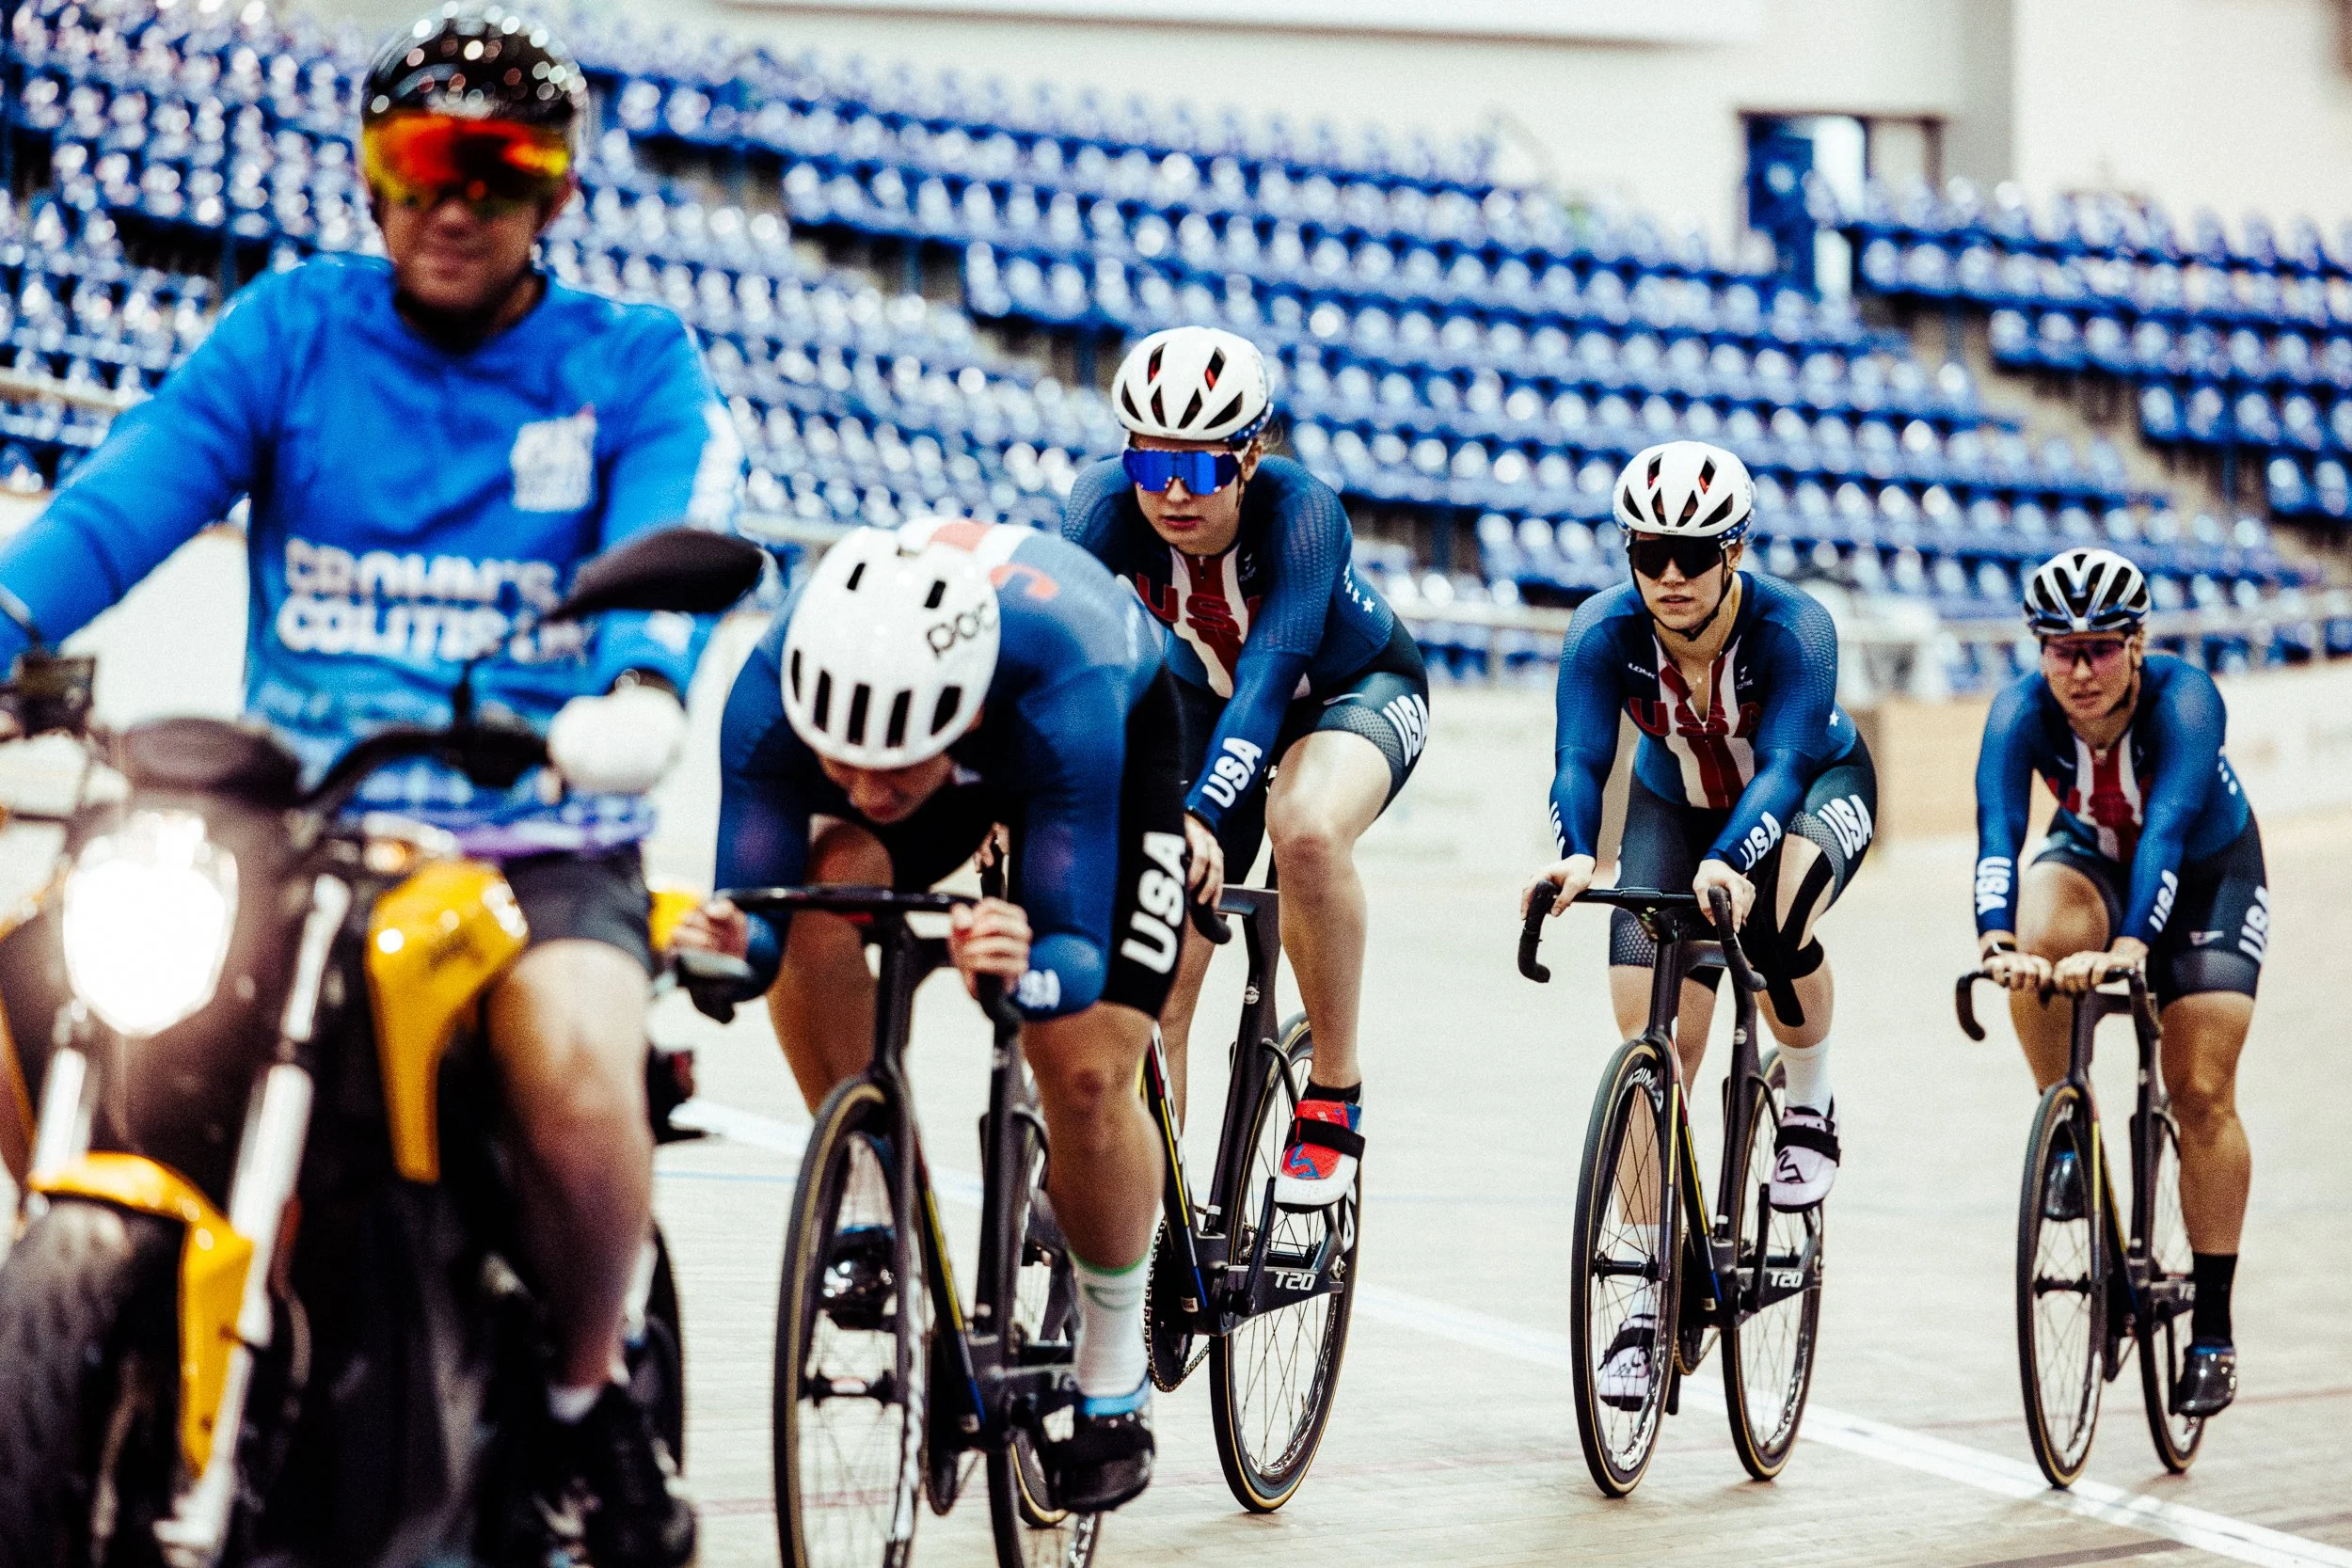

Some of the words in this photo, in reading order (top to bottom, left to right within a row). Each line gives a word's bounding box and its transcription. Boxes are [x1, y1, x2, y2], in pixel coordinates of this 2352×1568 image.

[1382, 693, 1430, 767] USA
[1628, 697, 1763, 738] USA
[1201, 736, 1263, 809] USA
[1740, 811, 1782, 871] USA
[1817, 794, 1873, 861] USA
[1120, 832, 1186, 974] USA
[1976, 856, 2012, 916] USA
[2149, 869, 2179, 933] USA
[2238, 885, 2268, 964] USA
[1275, 1271, 1316, 1291] T20
[1771, 1271, 1804, 1288] T20
